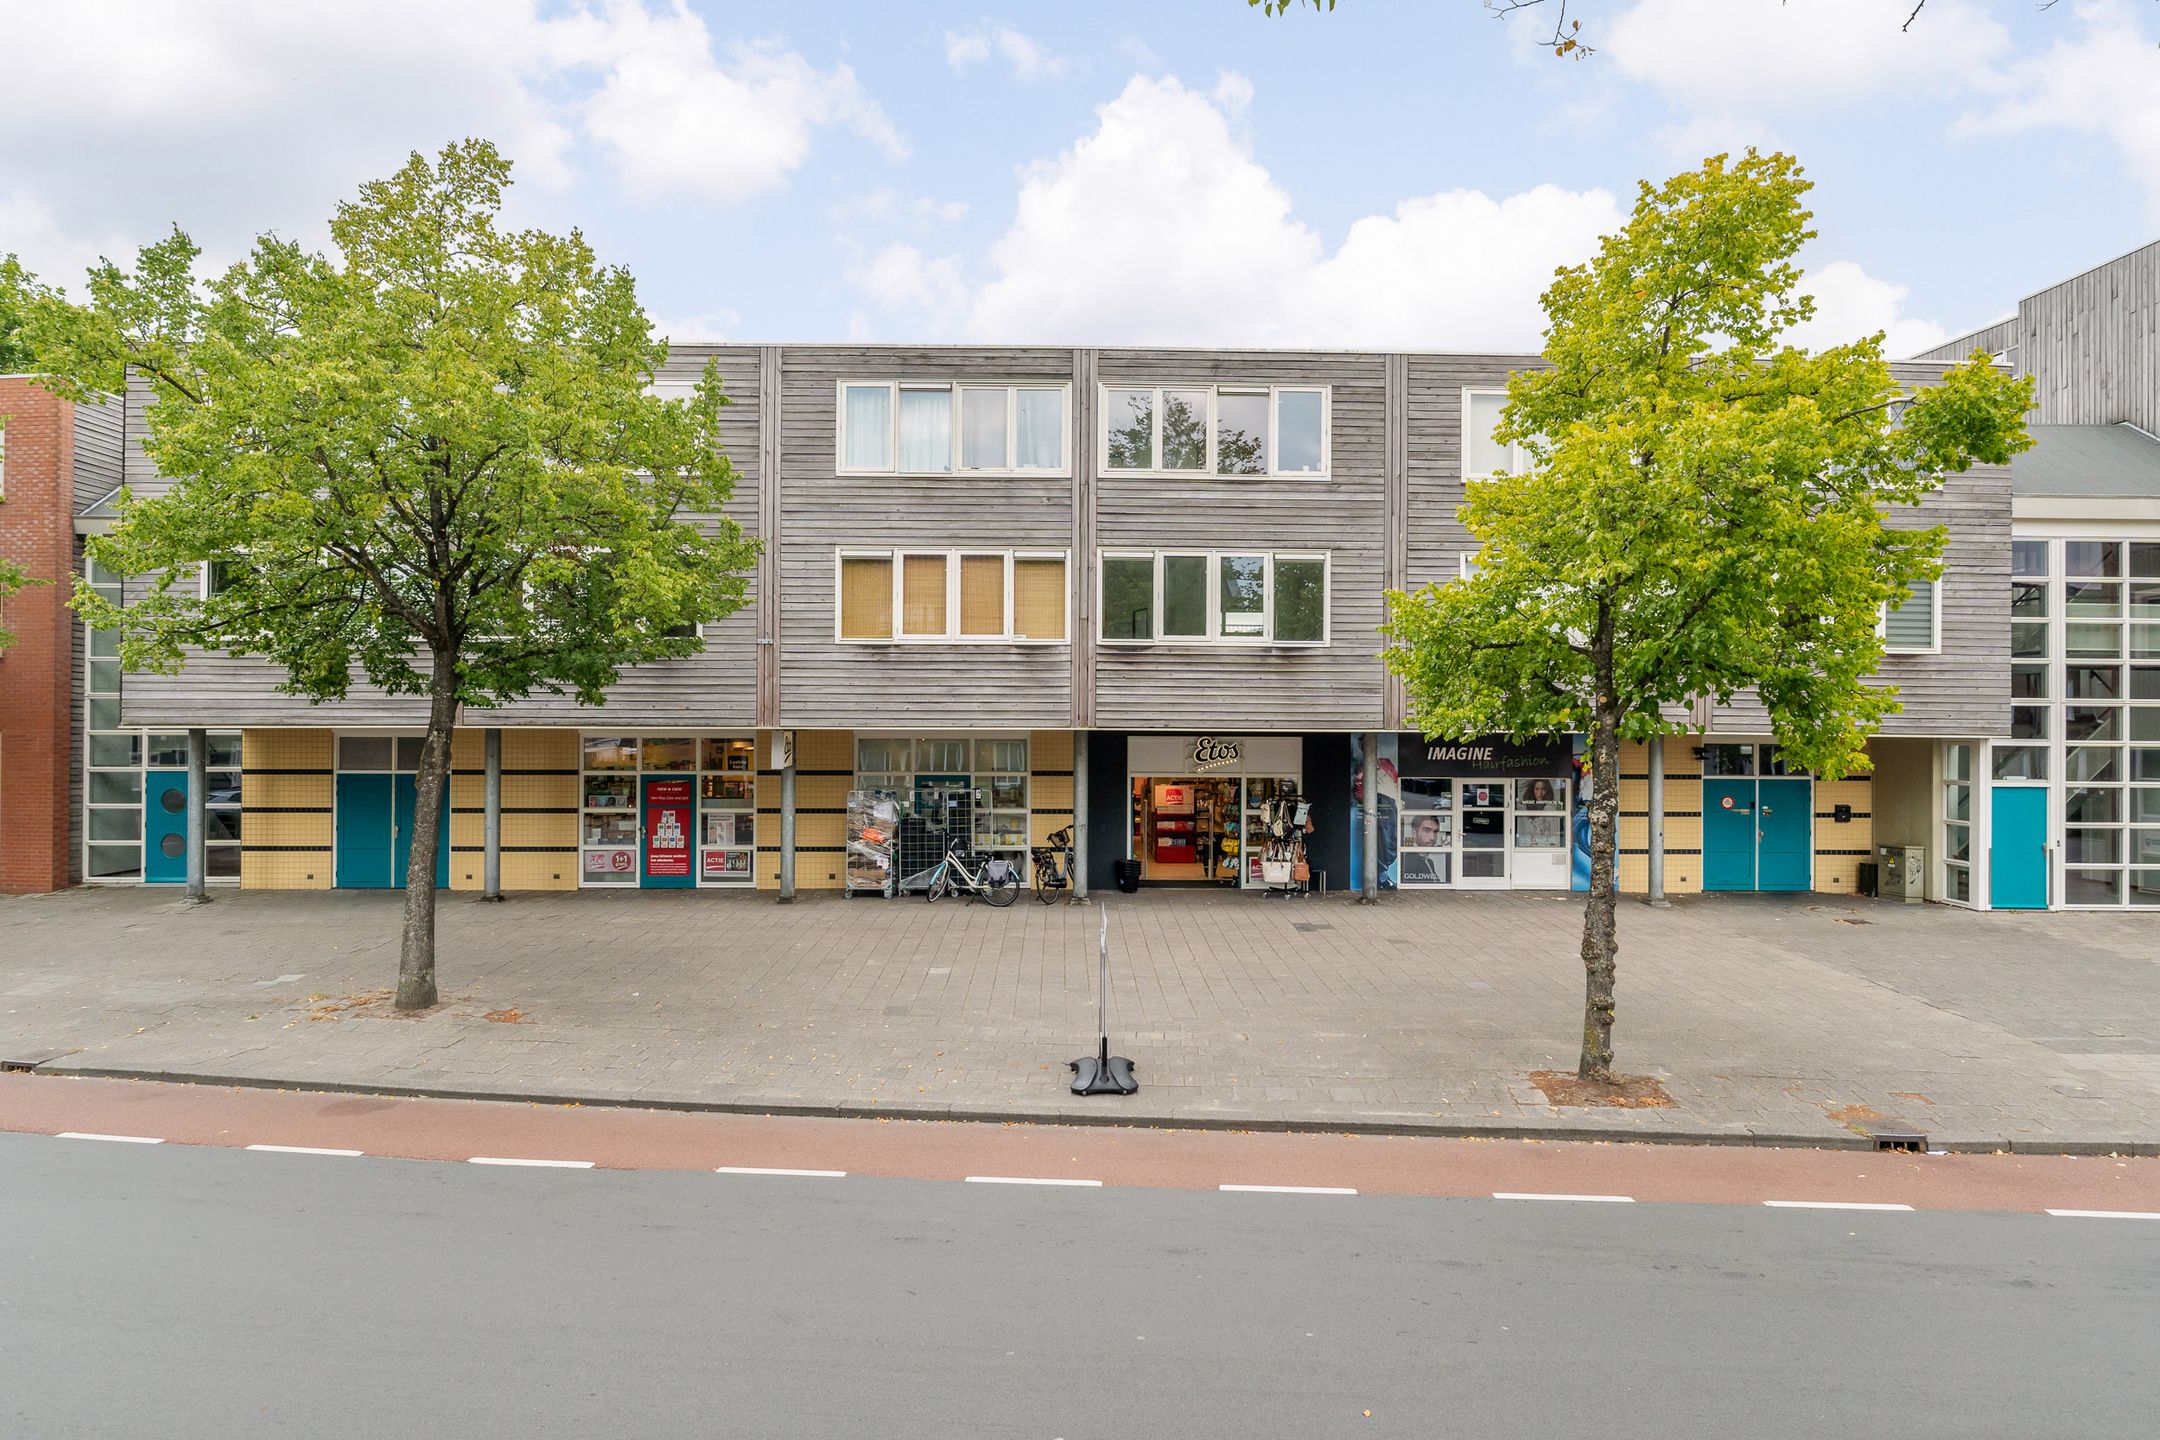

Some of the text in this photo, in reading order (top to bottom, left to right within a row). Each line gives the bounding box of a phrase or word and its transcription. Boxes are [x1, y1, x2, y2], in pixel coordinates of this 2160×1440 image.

[1195, 737, 1239, 762] Etos
[1427, 747, 1493, 760] IMAGINE
[1472, 755, 1550, 771] Hairfashion
[616, 855, 628, 863] 1+1
